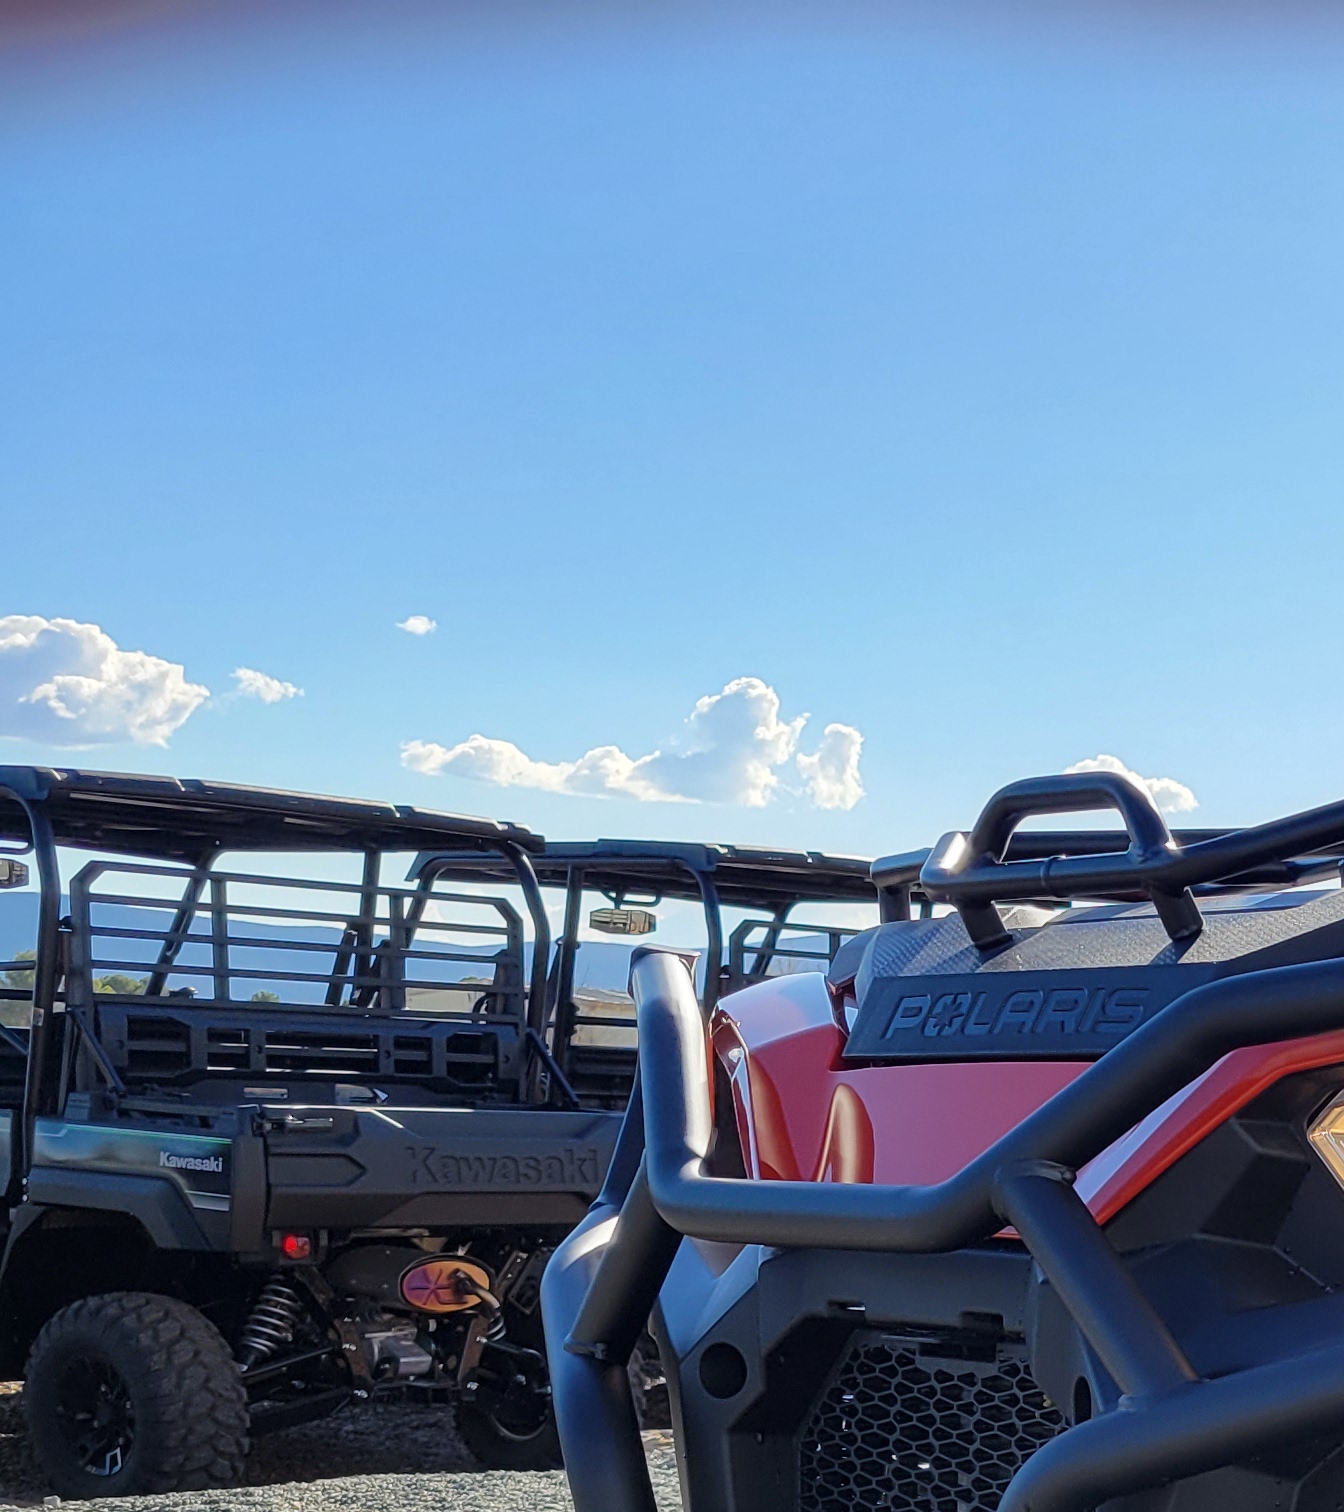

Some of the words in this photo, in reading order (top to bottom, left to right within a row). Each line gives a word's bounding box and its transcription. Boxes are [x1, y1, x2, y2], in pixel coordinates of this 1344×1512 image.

[880, 987, 1150, 1040] POLARIS
[160, 1150, 223, 1172] Kawasaki
[404, 1146, 598, 1184] Kawasaki
